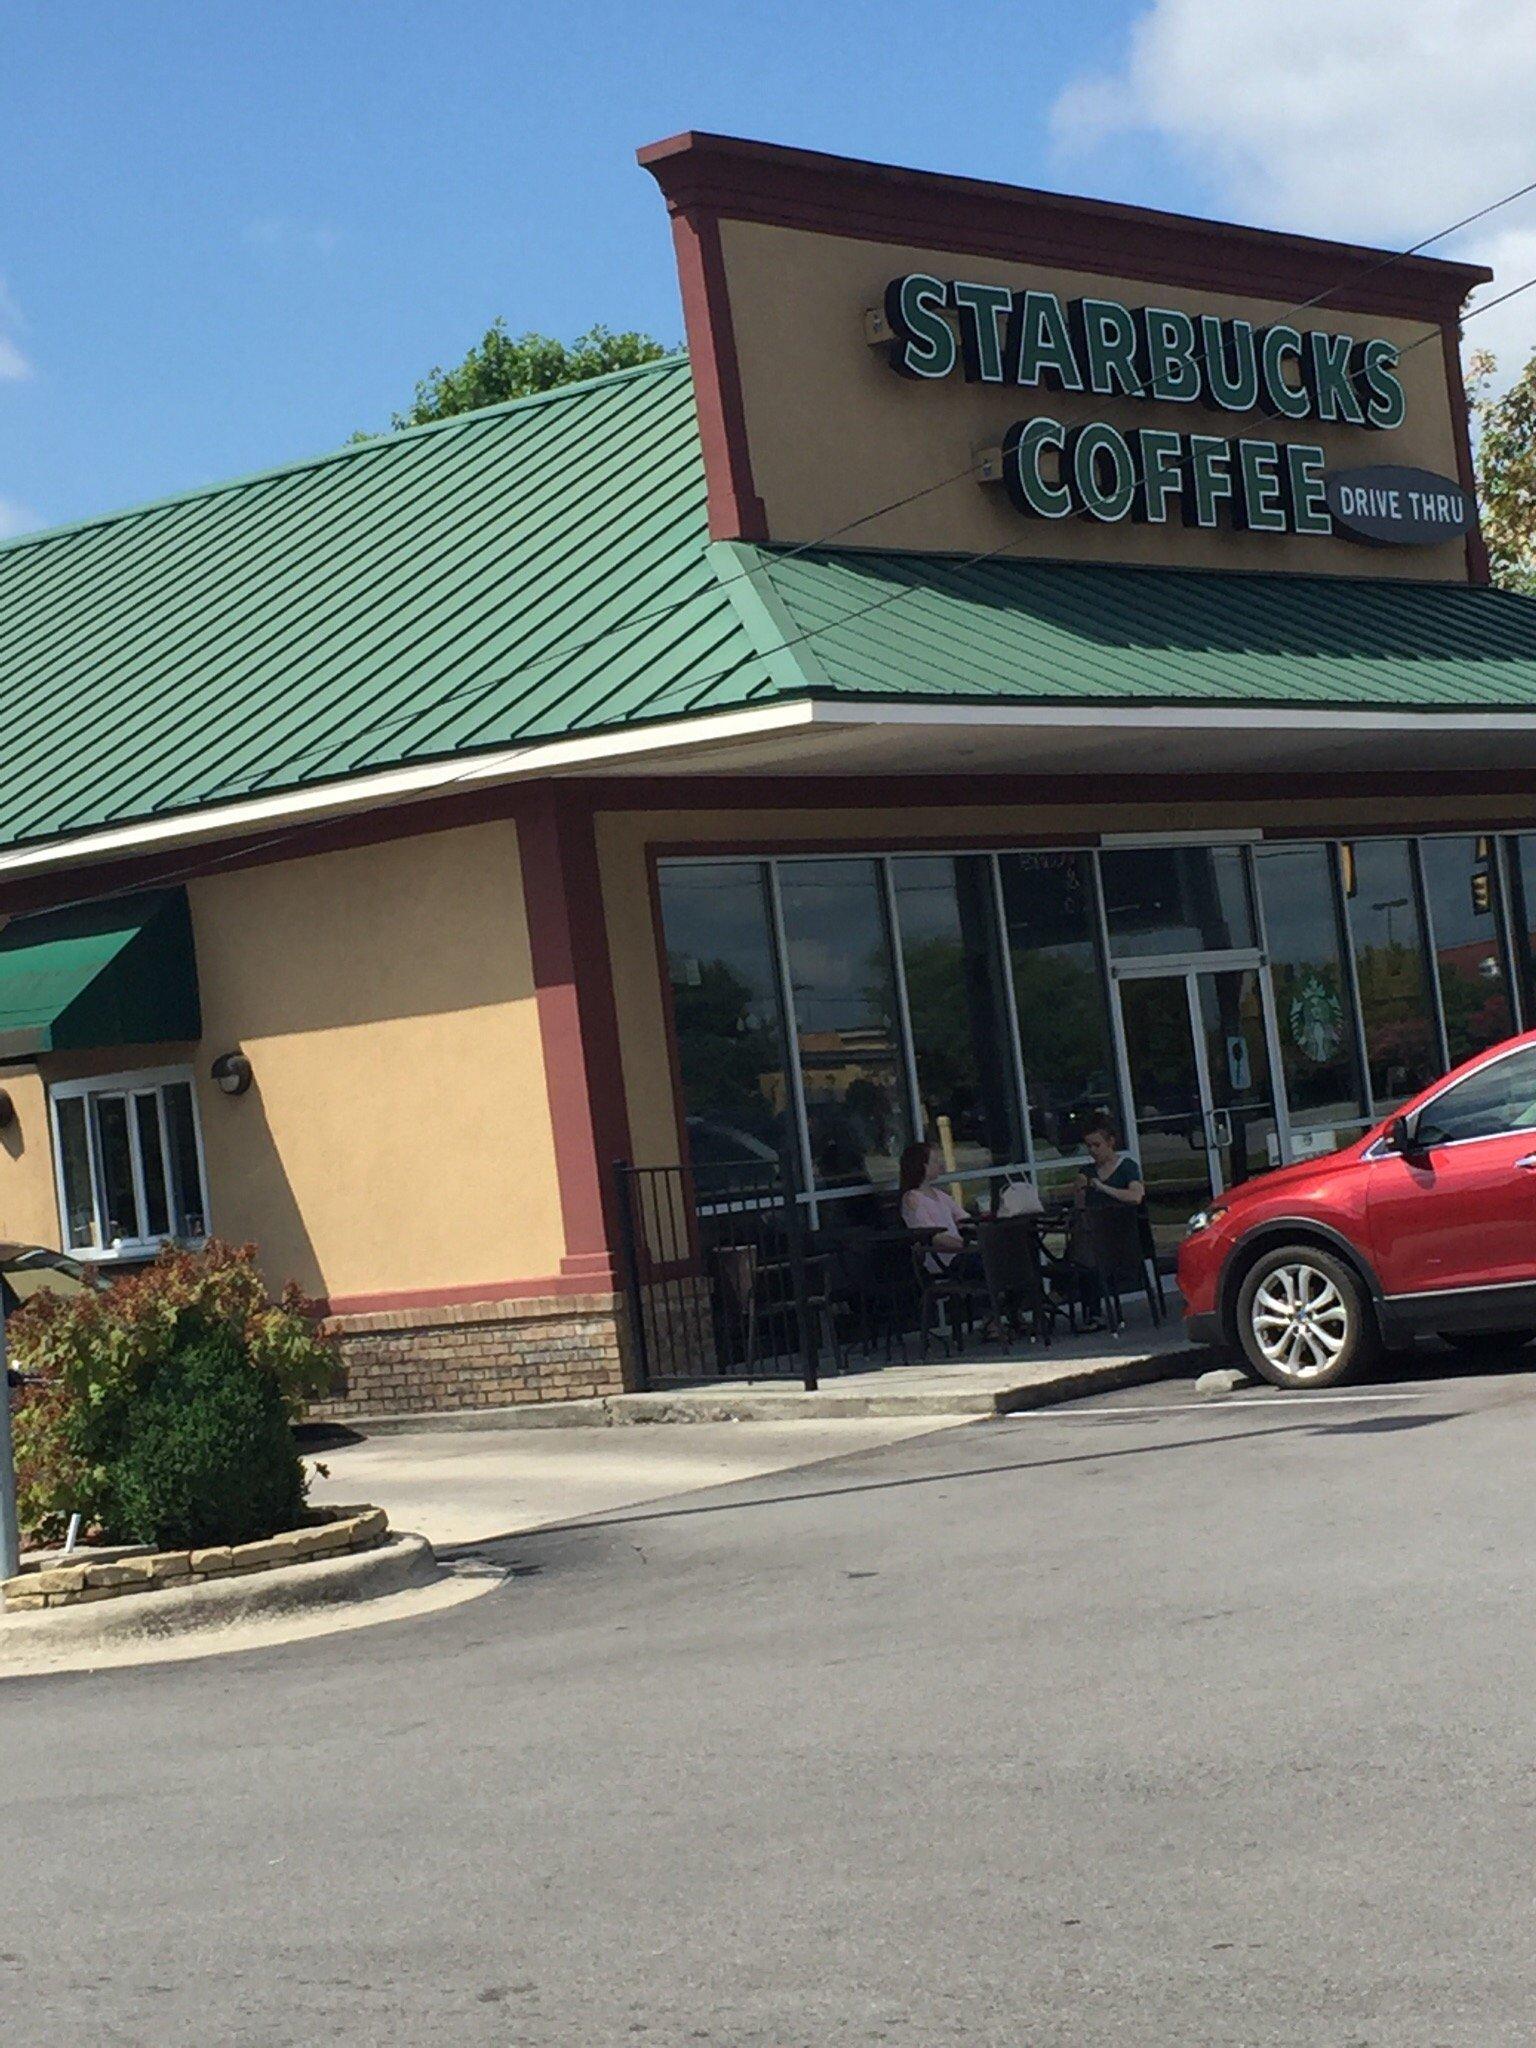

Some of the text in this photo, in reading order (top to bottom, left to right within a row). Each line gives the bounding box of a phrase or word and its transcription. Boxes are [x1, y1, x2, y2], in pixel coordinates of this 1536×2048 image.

[900, 273, 1406, 430] STARBUCKS
[1017, 416, 1334, 535] COFFEE
[1340, 486, 1464, 523] DRIVE THRU
